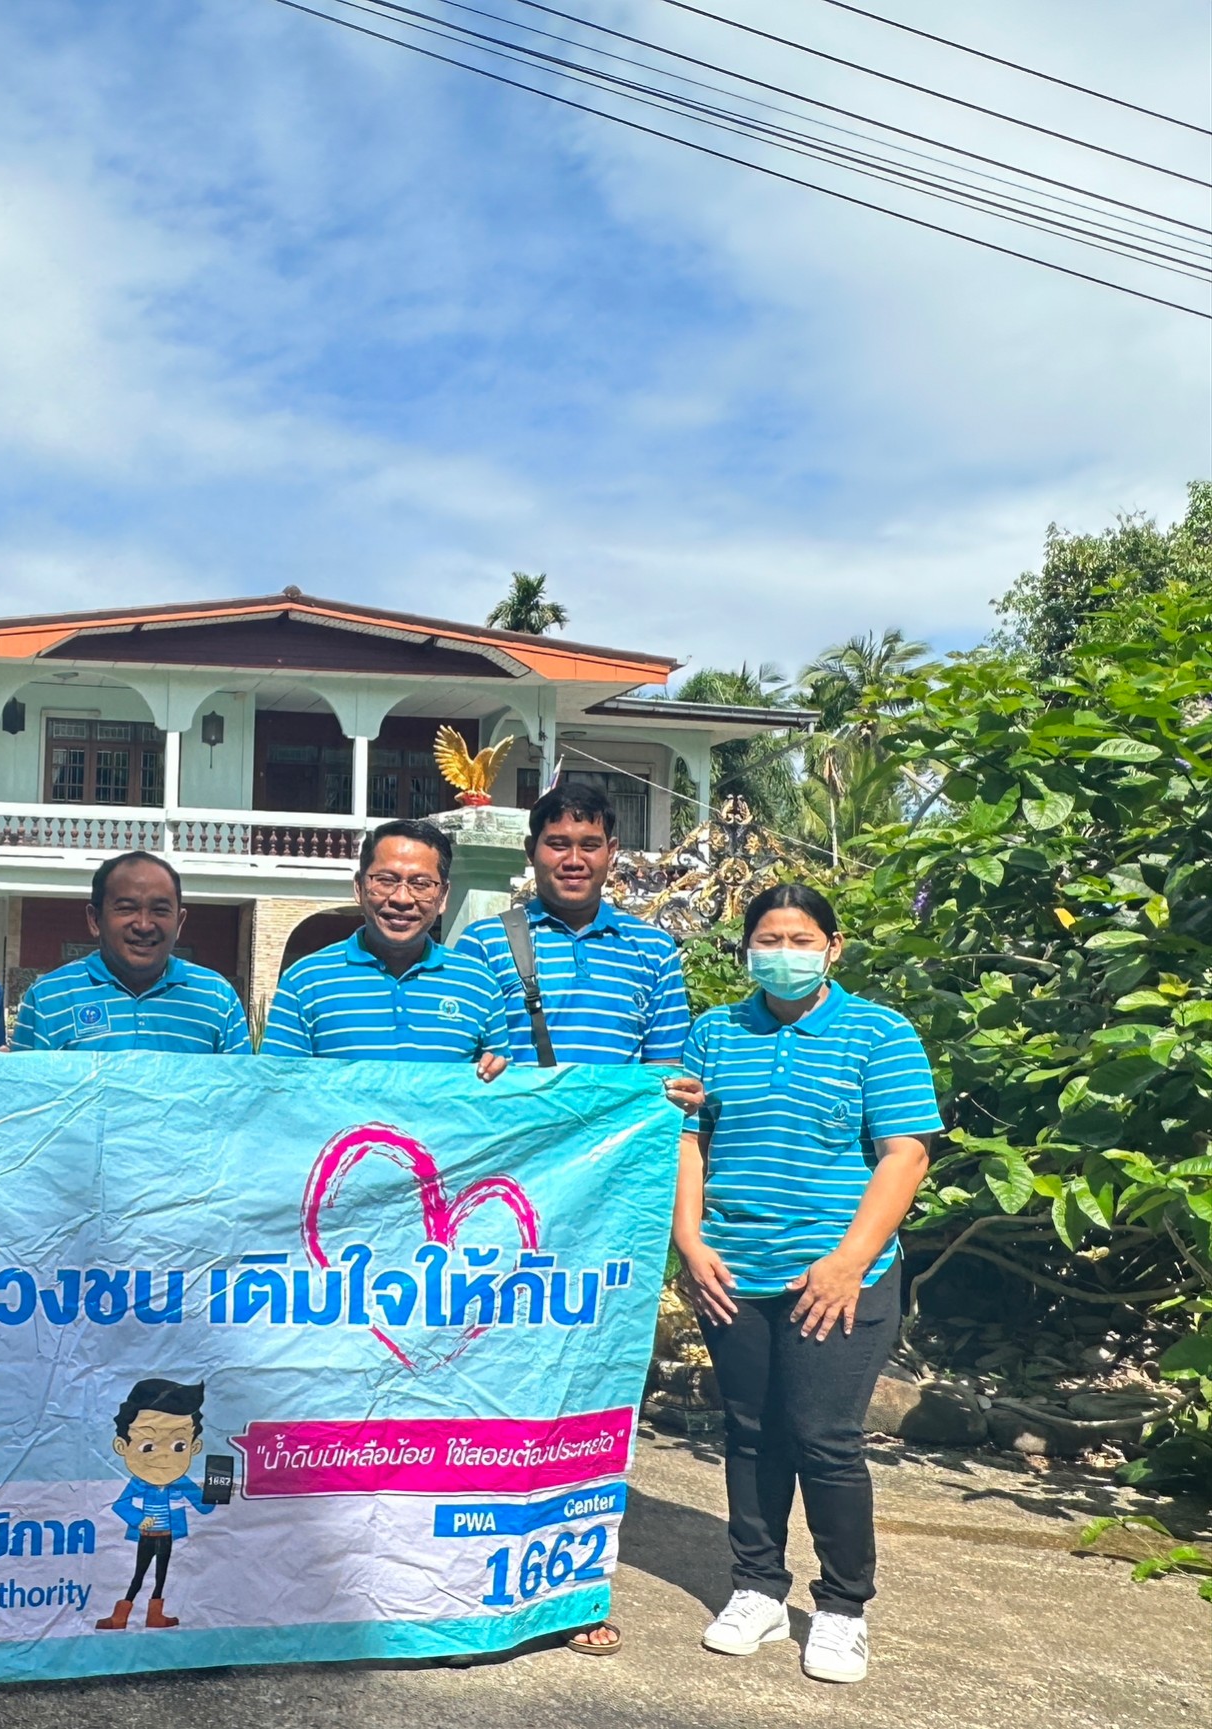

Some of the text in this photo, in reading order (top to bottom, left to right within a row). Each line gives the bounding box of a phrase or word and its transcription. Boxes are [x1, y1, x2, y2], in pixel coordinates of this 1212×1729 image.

[209, 1243, 632, 1327] เติมใจให้กัน"
[452, 1492, 616, 1533] PWA Center
[482, 1525, 608, 1606] 1662
